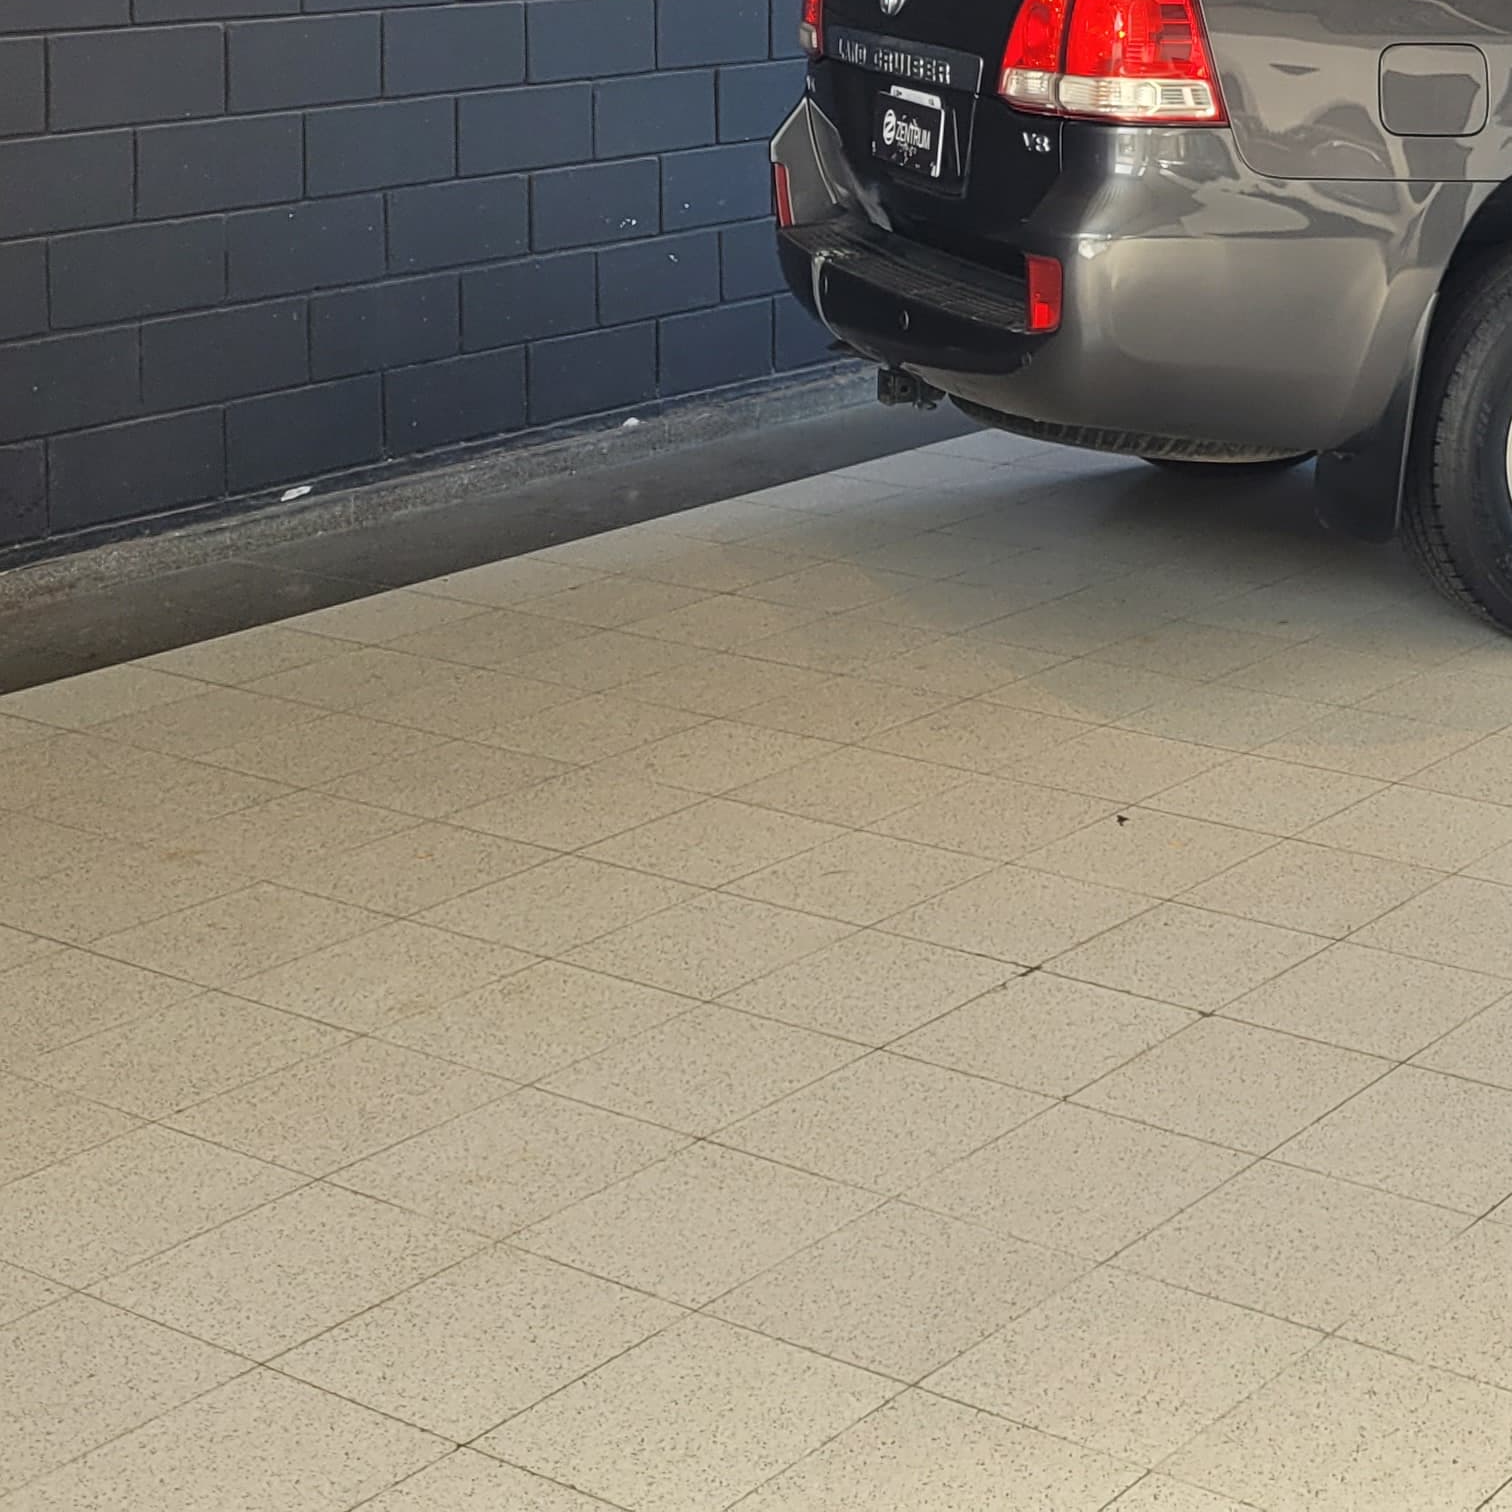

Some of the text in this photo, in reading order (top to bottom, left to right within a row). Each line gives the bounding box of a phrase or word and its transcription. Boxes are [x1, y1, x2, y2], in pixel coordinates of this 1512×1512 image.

[873, 48, 950, 85] CRUISER
[895, 120, 932, 151] ZENTRUM
[1022, 131, 1051, 153] V8
